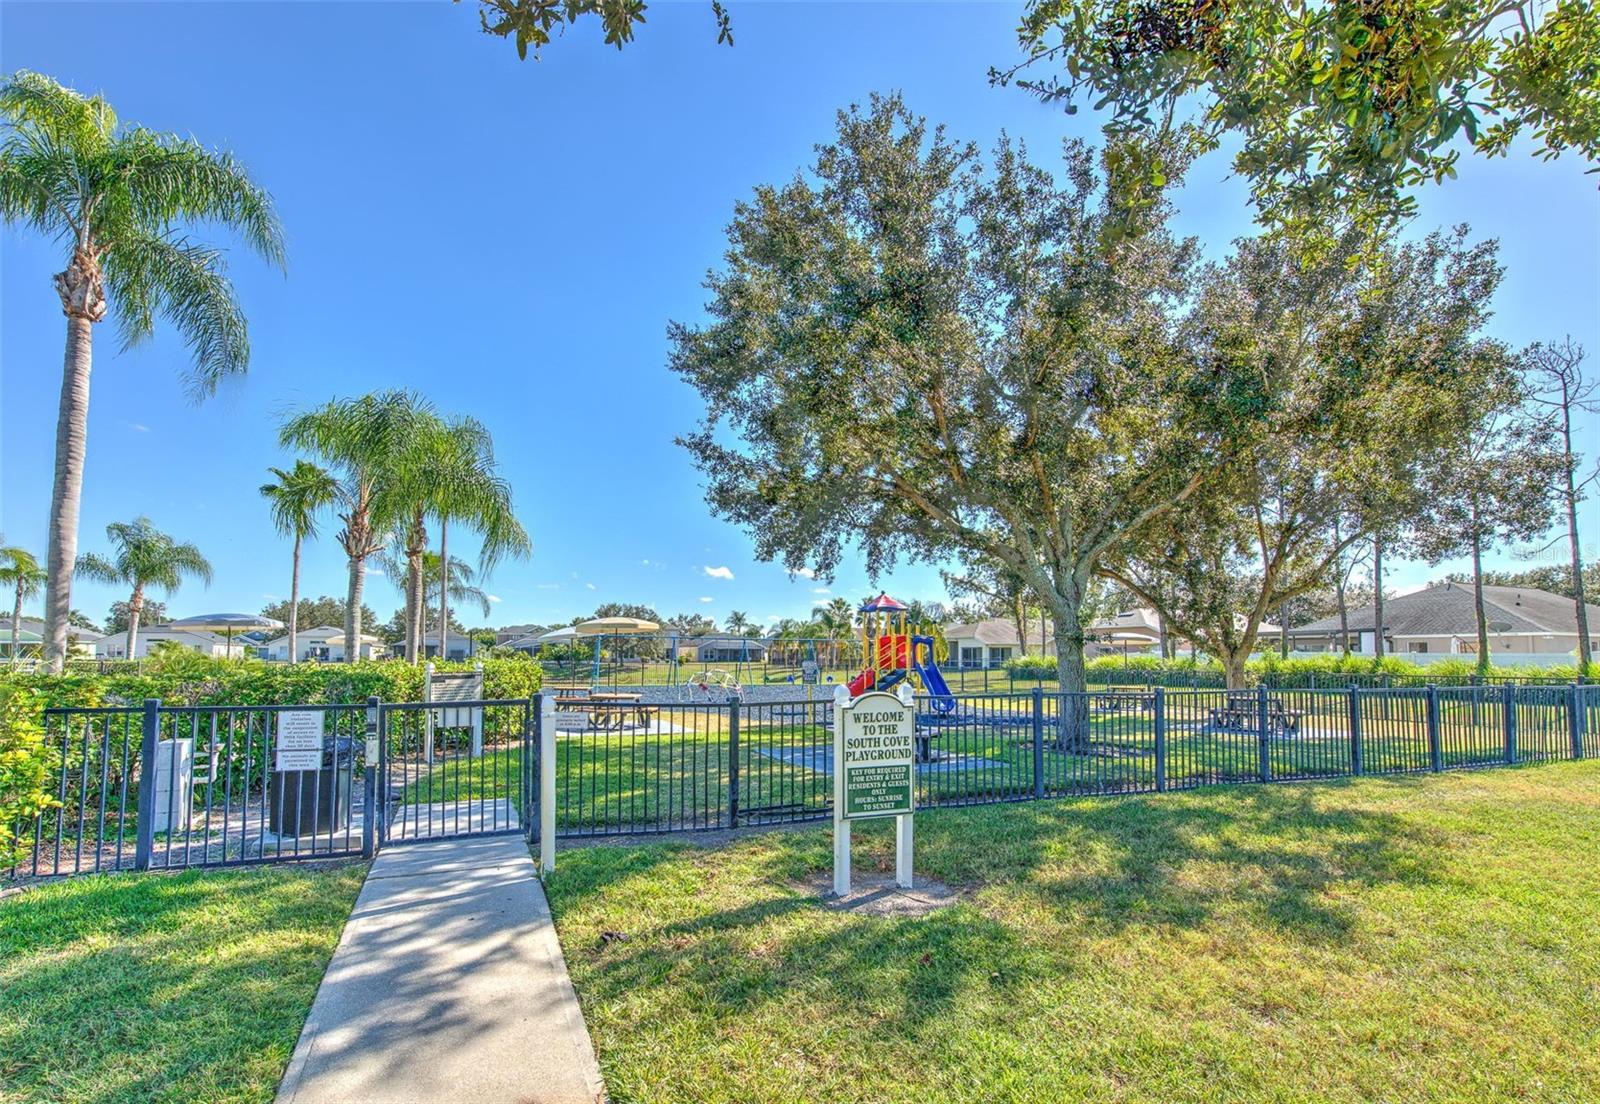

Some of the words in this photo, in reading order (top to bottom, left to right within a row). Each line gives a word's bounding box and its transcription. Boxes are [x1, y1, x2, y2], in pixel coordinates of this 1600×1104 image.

[853, 712, 904, 723] WELCOME
[863, 725, 875, 735] TO
[878, 724, 898, 734] THE
[847, 738, 880, 749] SOUTH
[883, 736, 910, 747] COVE
[846, 748, 911, 761] PLAYGROUND
